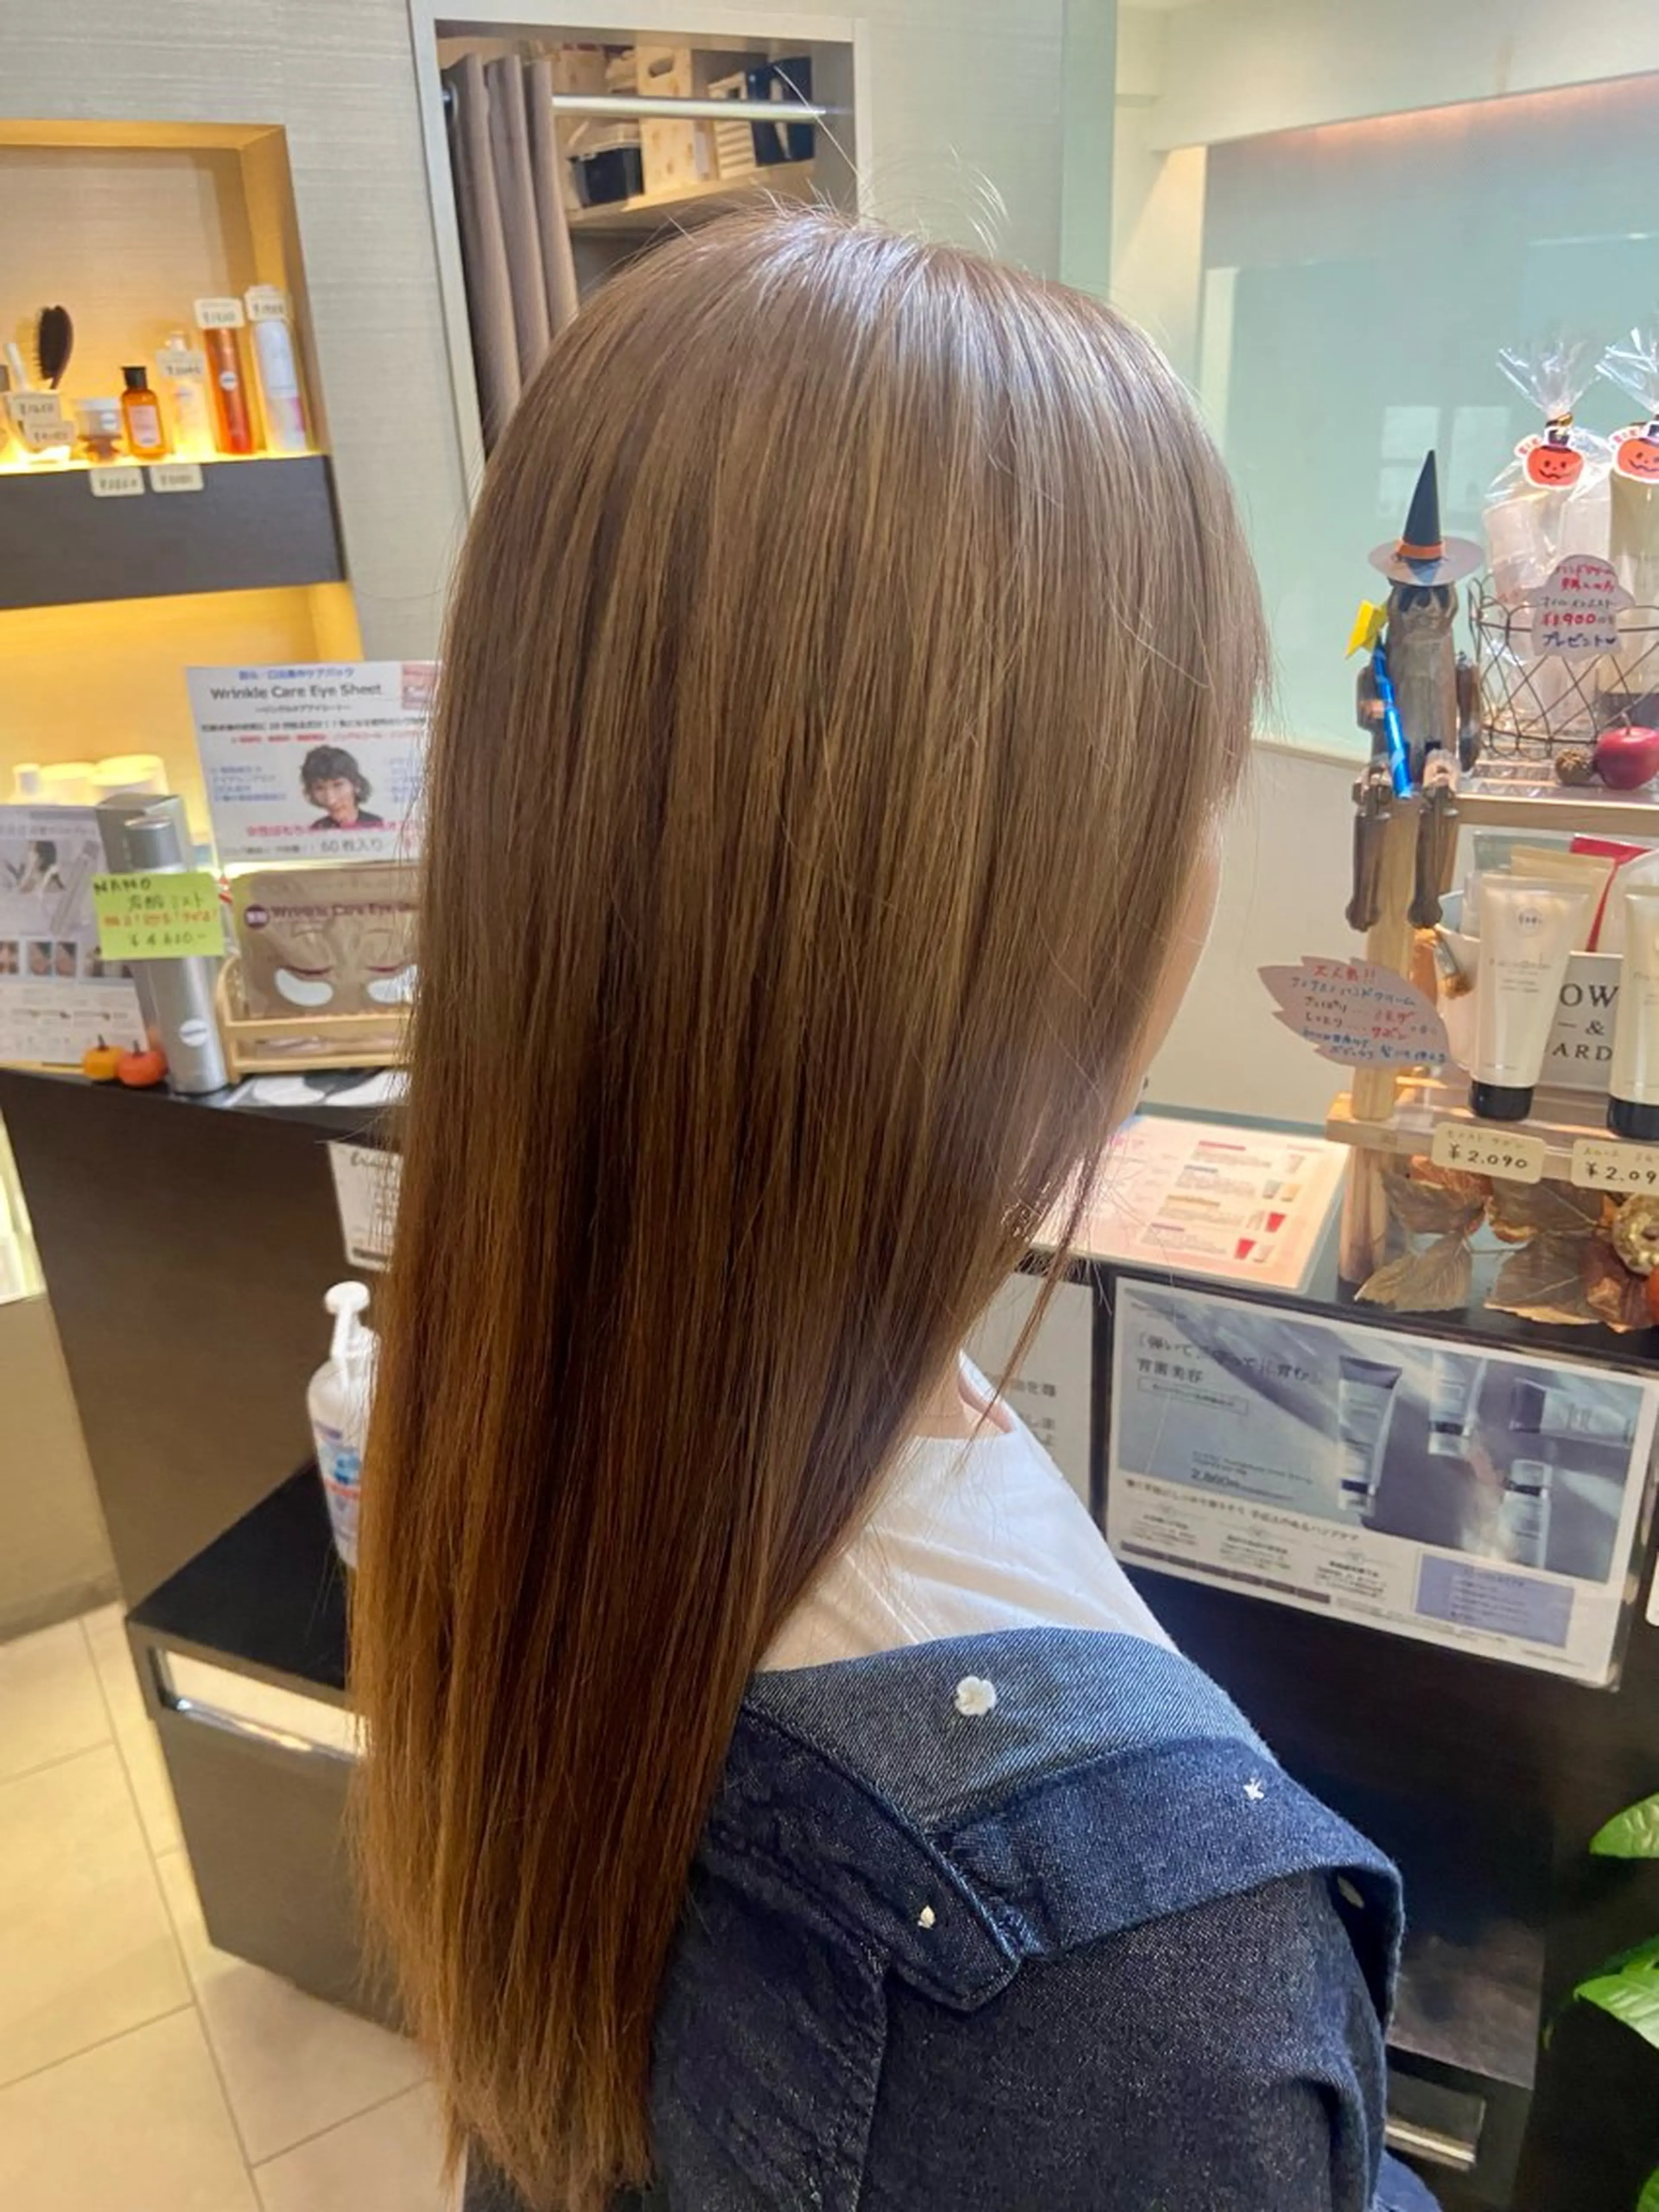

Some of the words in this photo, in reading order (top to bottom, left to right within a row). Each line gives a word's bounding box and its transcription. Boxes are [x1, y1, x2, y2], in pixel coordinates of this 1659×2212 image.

[1543, 631, 1603, 647] プレゼント
[210, 685, 267, 700] Wrinkle
[271, 685, 306, 698] Care
[310, 684, 337, 698] Eye
[340, 683, 381, 696] Sheet
[1585, 1020, 1605, 1036] &
